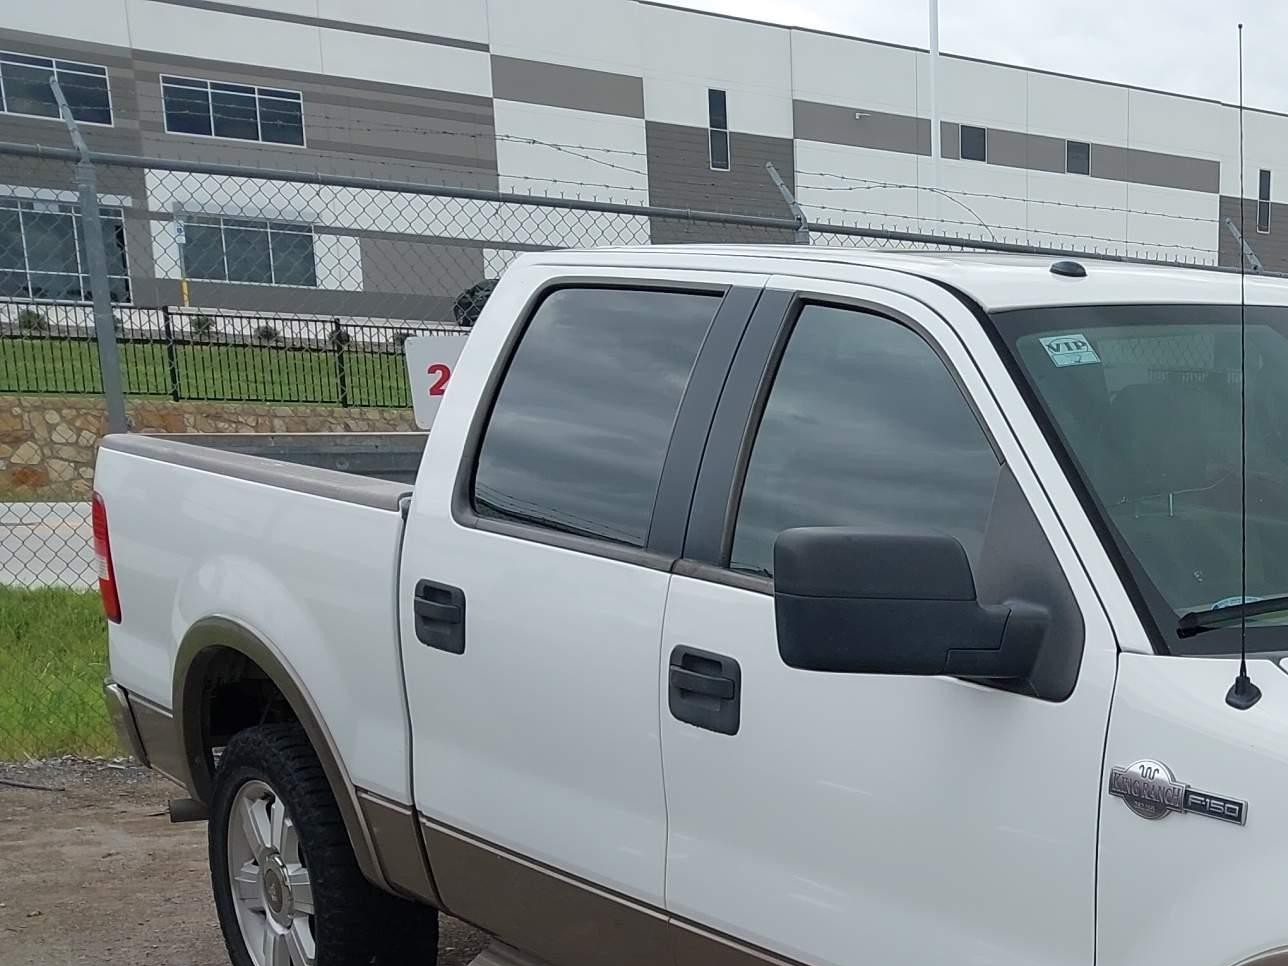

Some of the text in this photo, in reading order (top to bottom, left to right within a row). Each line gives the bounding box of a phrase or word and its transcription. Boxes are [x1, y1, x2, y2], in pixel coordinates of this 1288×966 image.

[1045, 340, 1088, 352] VIP
[427, 364, 450, 396] 2
[1112, 773, 1142, 797] KING
[1143, 781, 1182, 807] RANCH
[1188, 794, 1239, 817] F-150
